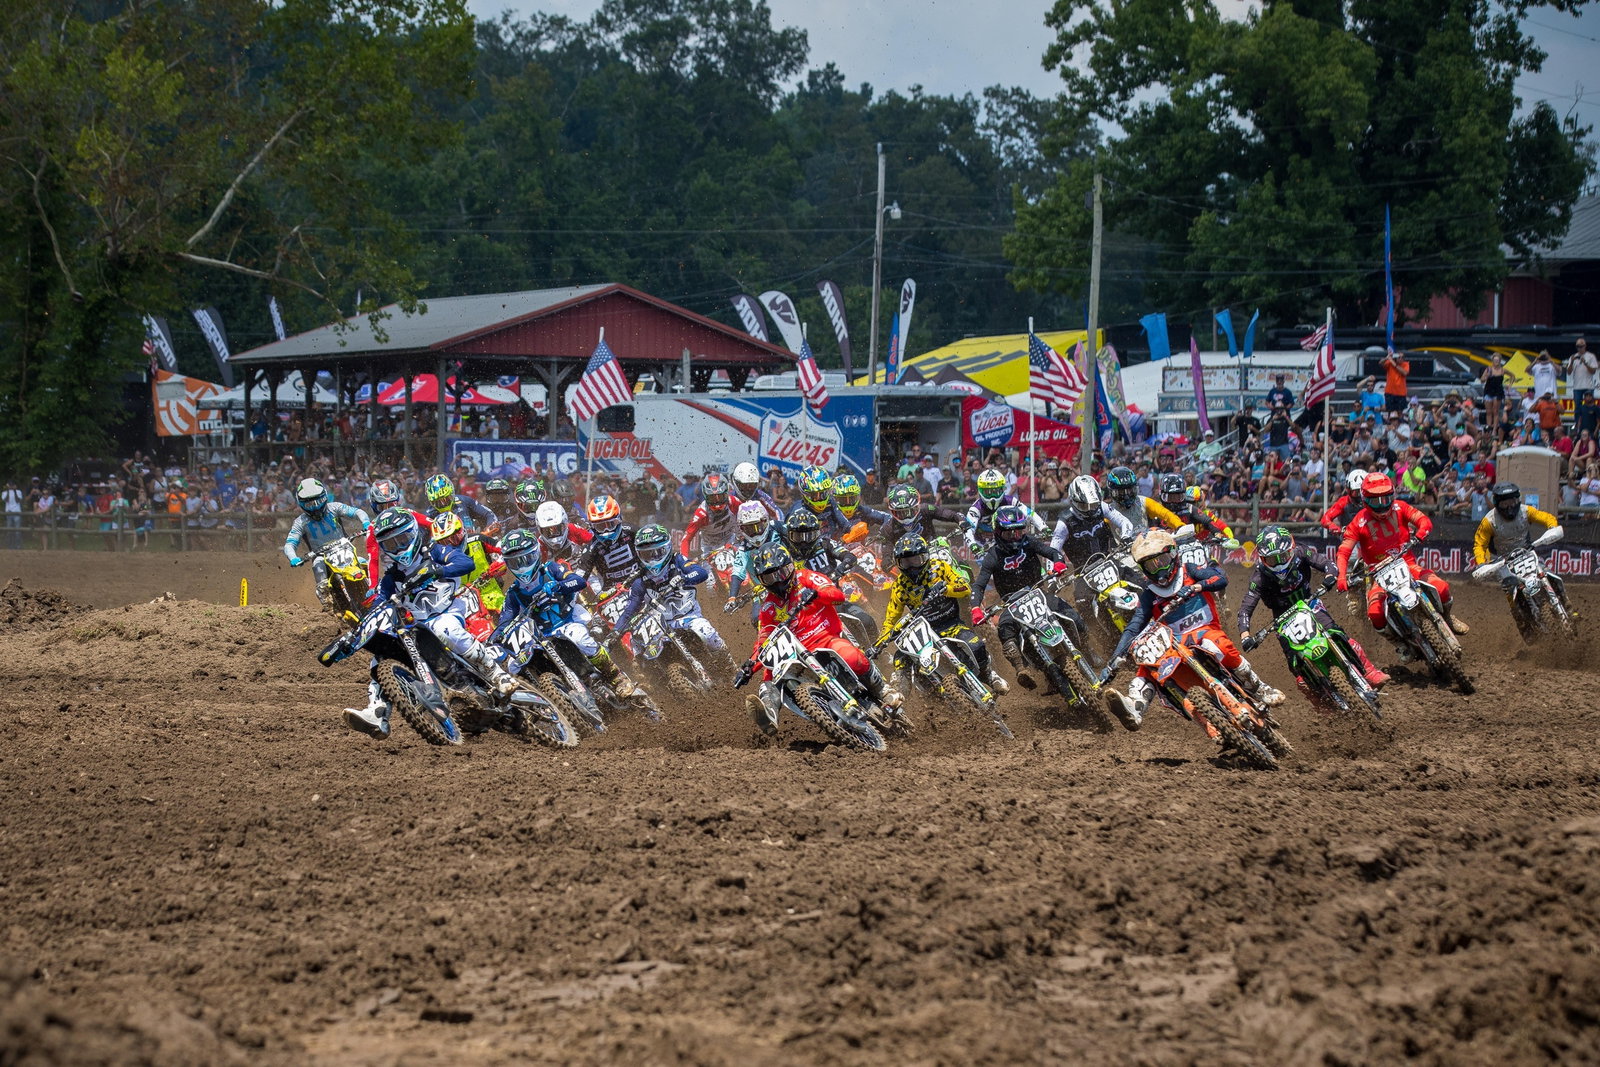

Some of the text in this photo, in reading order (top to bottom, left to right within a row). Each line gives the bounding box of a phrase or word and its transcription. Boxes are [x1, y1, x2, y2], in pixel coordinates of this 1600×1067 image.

[976, 413, 1010, 433] LUCAS
[1020, 428, 1068, 443] LUCAS OIL
[584, 438, 653, 460] LUCAS OIL
[767, 437, 835, 467] LUCAS
[461, 450, 577, 476] BUD LIG
[307, 512, 338, 540] FLY
[1368, 511, 1401, 540] FLY
[809, 552, 831, 571] FLY
[1430, 548, 1461, 573] Bull
[1558, 550, 1592, 575] Bull
[1093, 566, 1117, 591] 39
[1019, 596, 1046, 623] 373
[1179, 613, 1205, 632] KTM
[507, 620, 533, 654] 14
[902, 621, 928, 654] 117
[767, 635, 795, 667] 24
